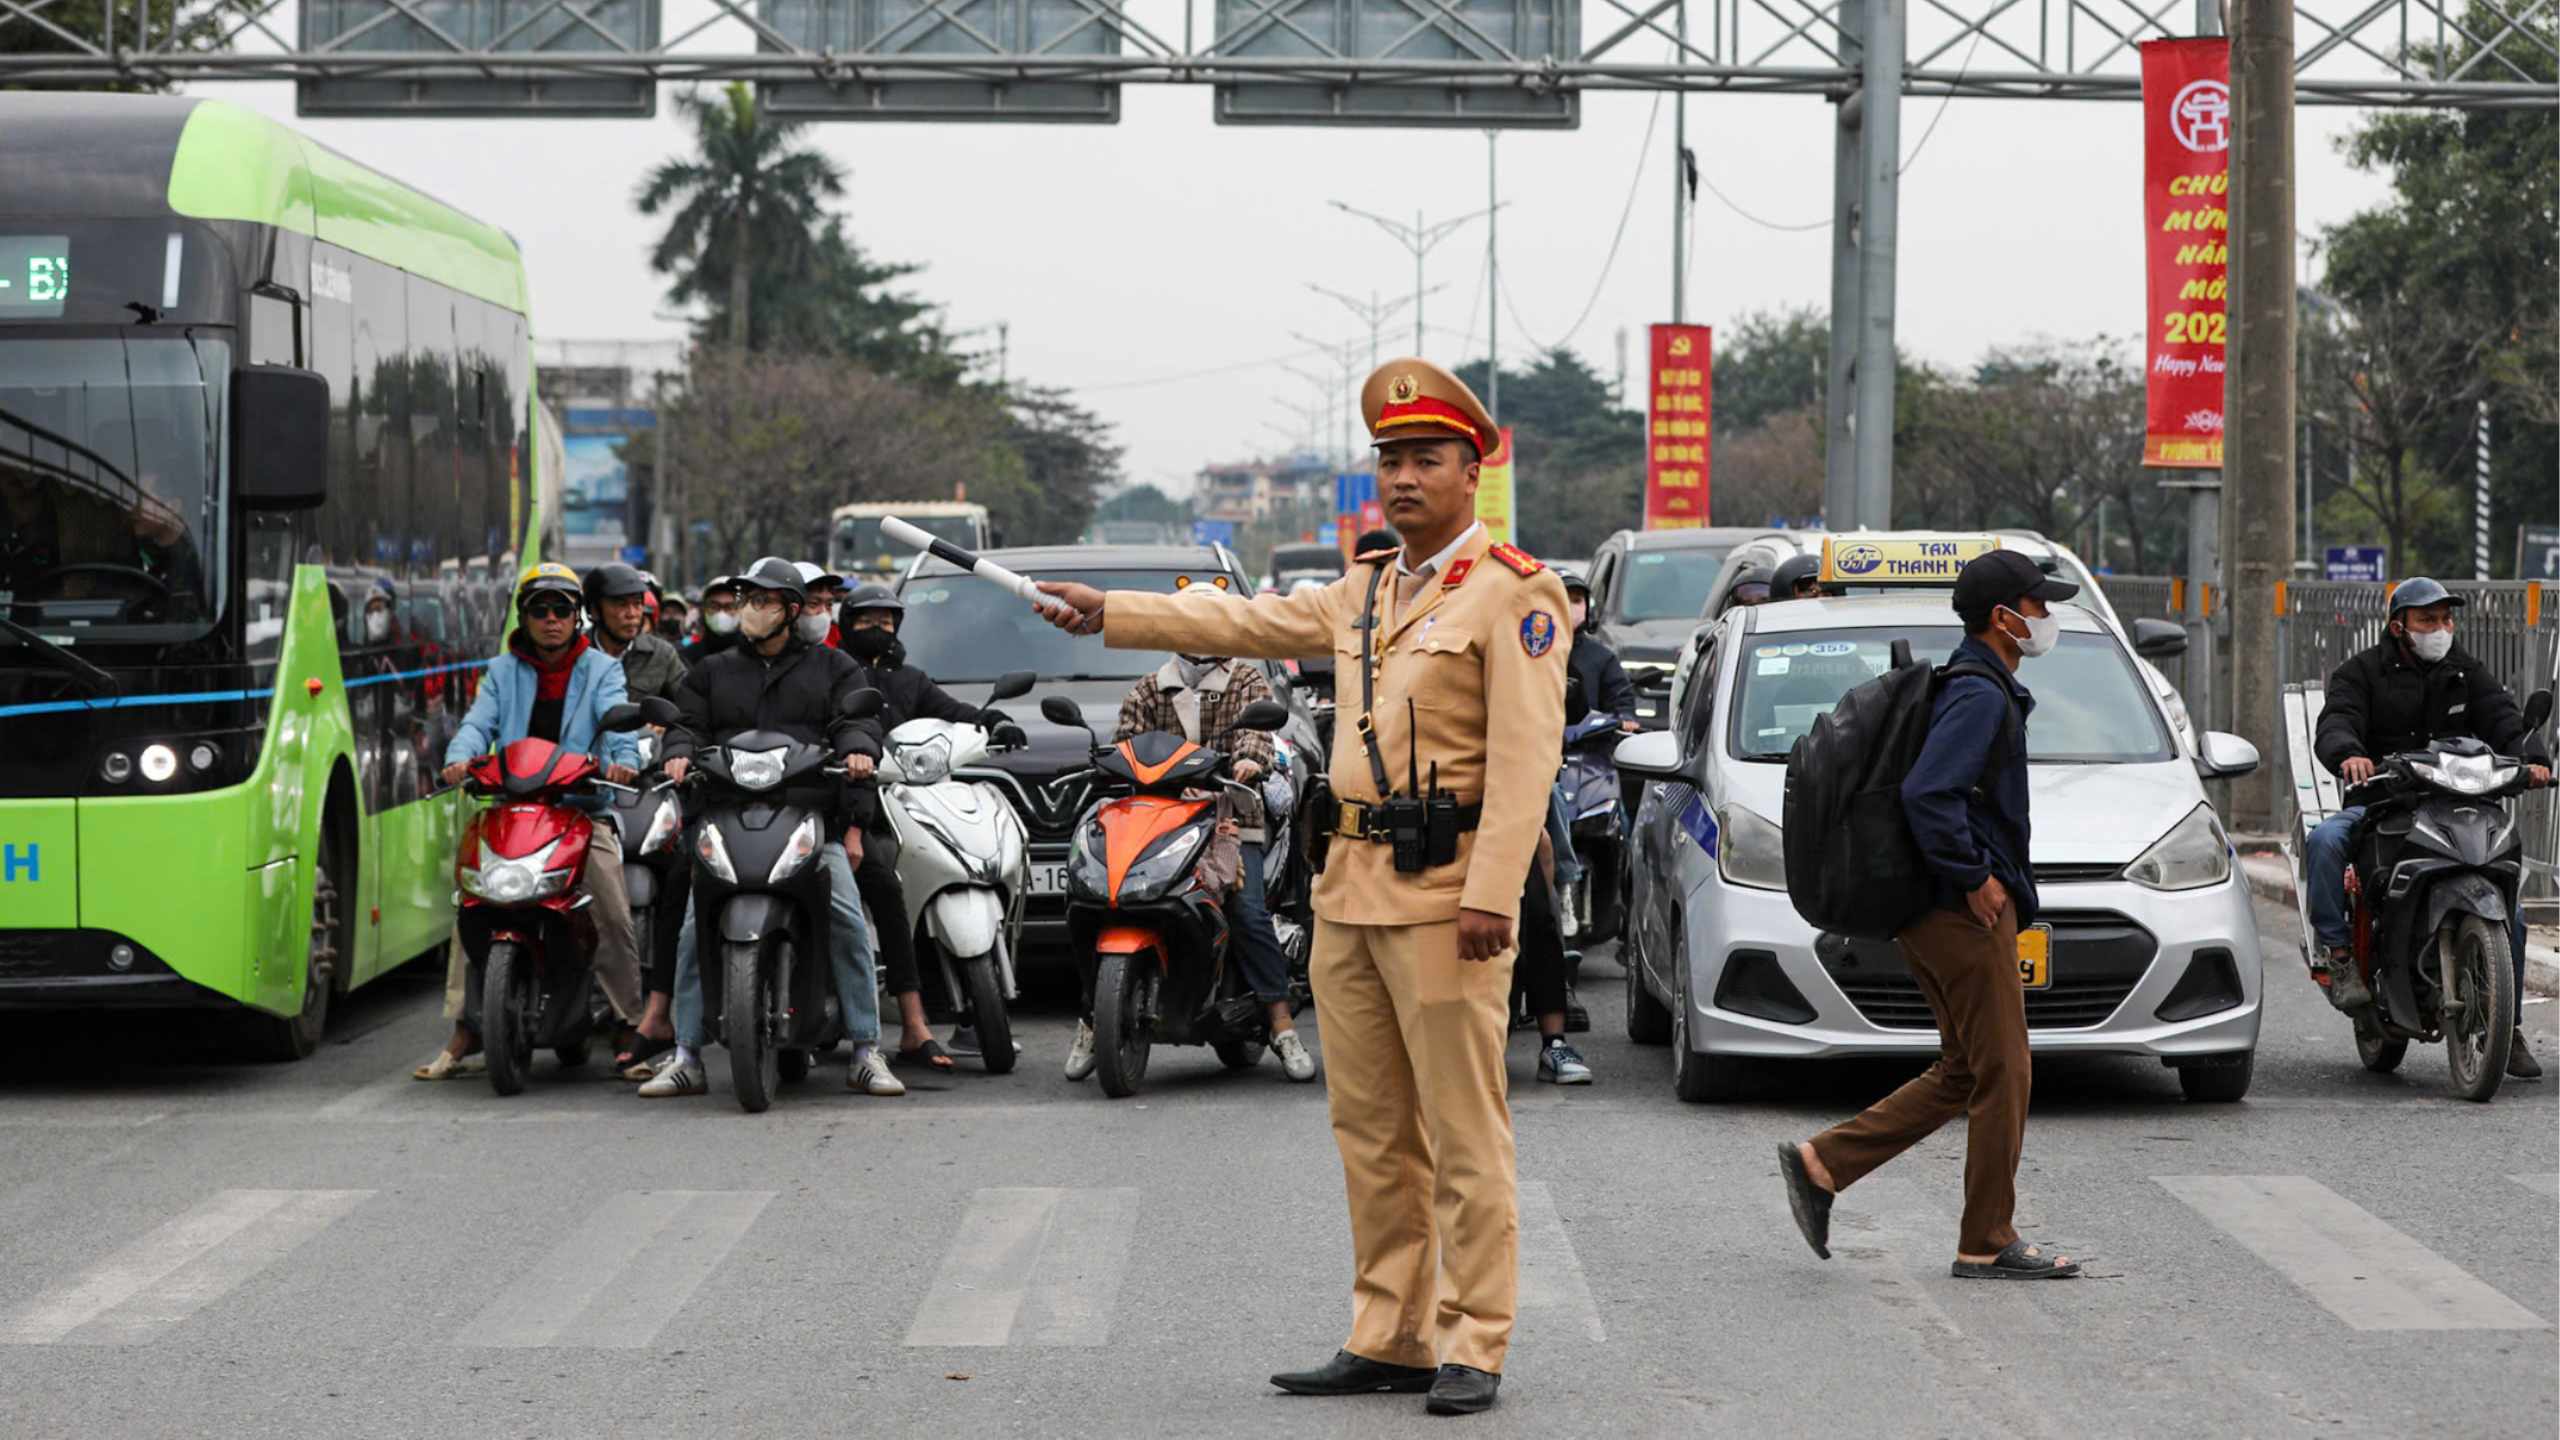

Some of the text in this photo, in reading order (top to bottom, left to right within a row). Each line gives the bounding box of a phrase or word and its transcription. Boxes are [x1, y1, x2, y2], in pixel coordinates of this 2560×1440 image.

[2169, 169, 2229, 196] CHÚ
[2162, 204, 2229, 232] MỪN
[2178, 274, 2227, 300] MỚ
[2164, 312, 2227, 344] 202
[2154, 353, 2196, 378] Happy
[1919, 543, 1957, 556] TAXI
[1887, 559, 1968, 575] THANH N
[1815, 643, 1850, 654] 355
